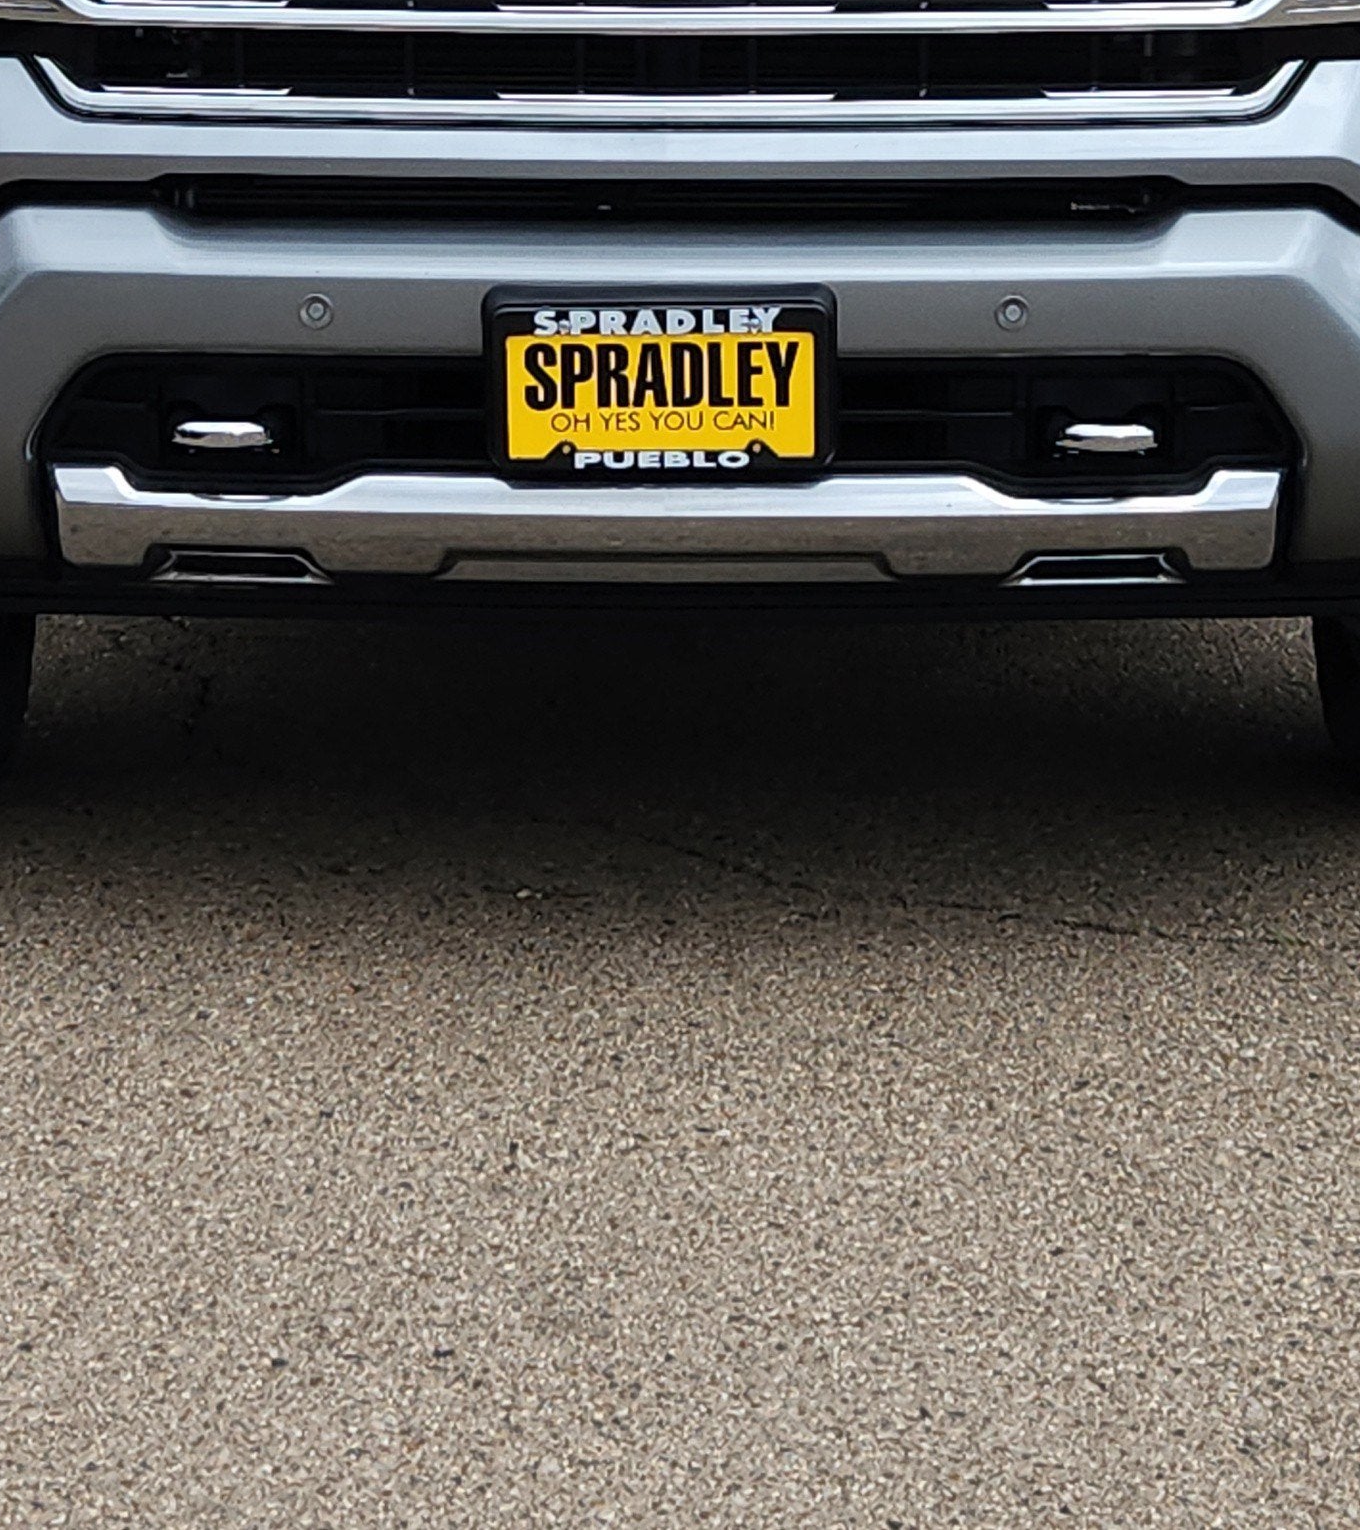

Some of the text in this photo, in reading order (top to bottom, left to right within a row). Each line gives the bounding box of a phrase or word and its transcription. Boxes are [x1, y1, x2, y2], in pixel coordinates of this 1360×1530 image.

[533, 306, 782, 336] SPRADLEY
[524, 341, 800, 411] SPRADLEY
[551, 410, 775, 432] OH YES YOU CAN!
[574, 450, 750, 470] PUEBLO
